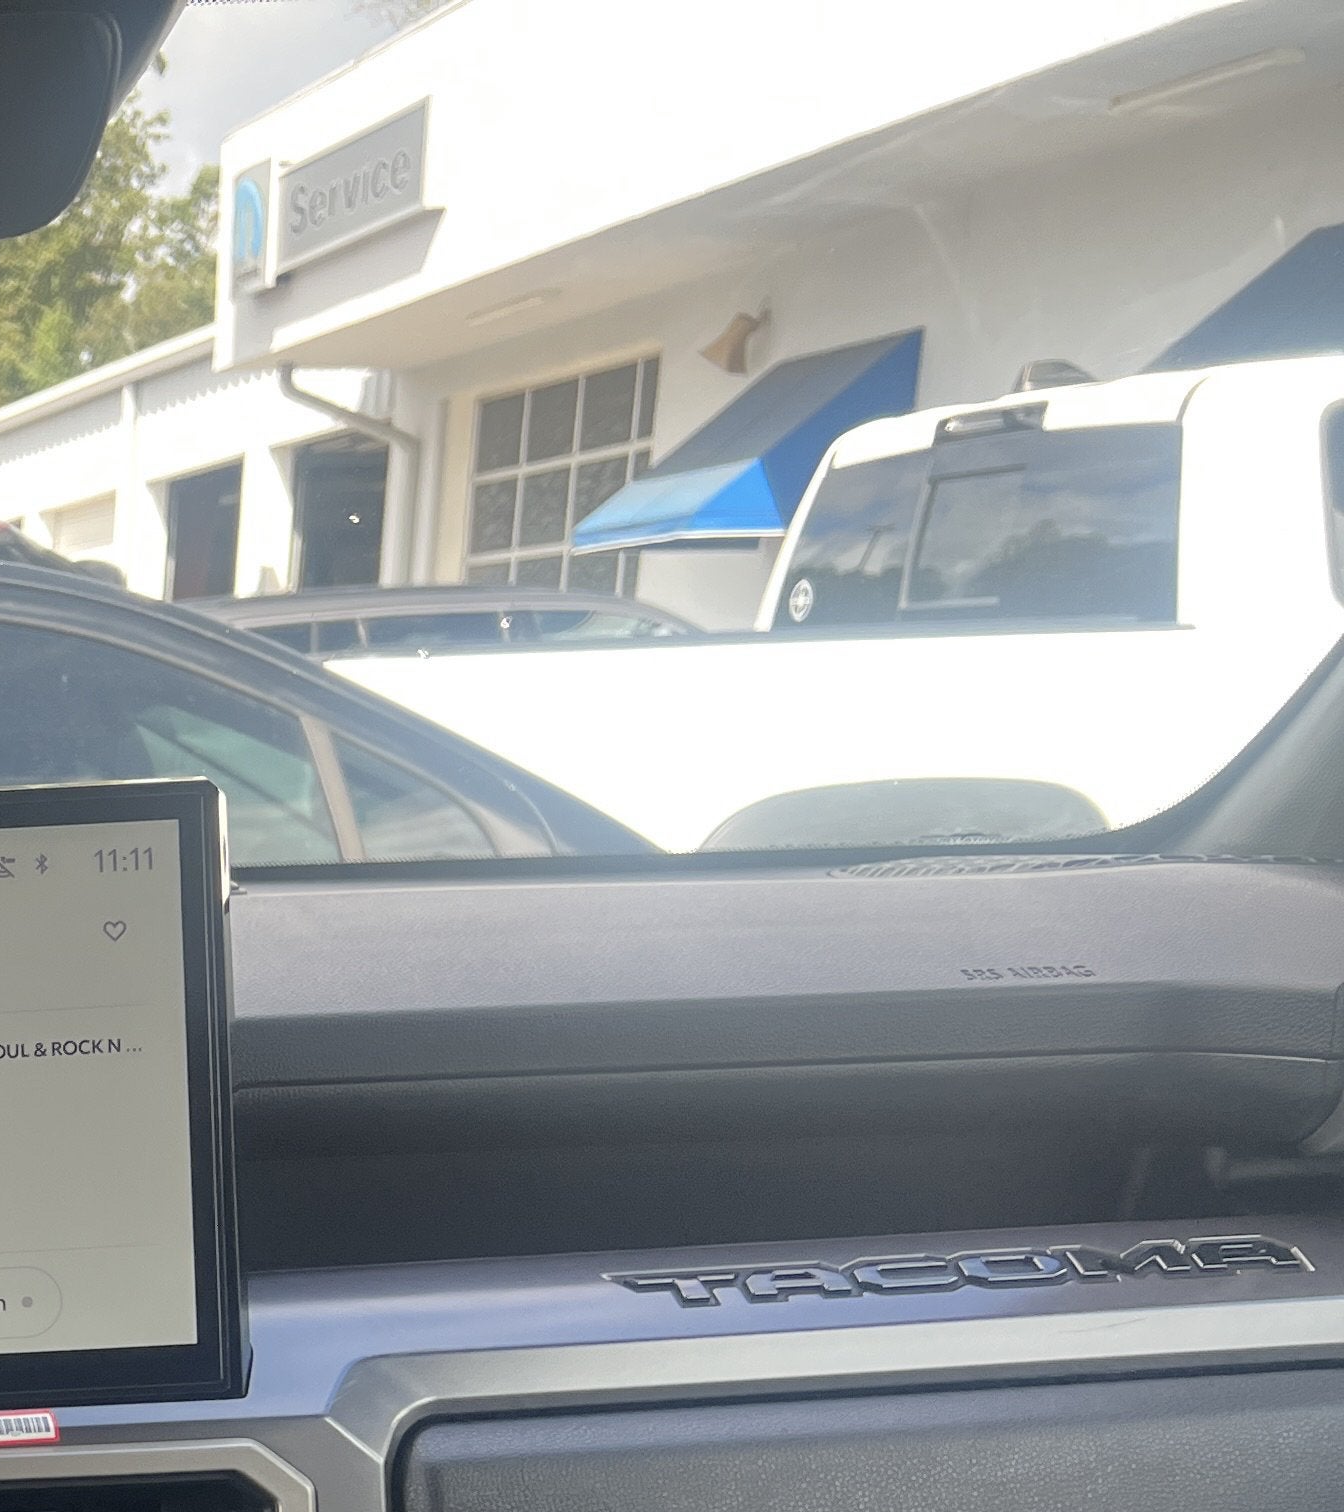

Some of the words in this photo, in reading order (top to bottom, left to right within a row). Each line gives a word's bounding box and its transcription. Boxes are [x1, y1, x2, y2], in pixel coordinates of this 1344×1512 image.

[289, 149, 411, 235] Service
[93, 847, 155, 872] 11:11
[960, 969, 1004, 981] SRS
[1007, 965, 1097, 979] AIRBAG
[34, 1043, 47, 1058] &
[51, 1039, 104, 1058] ROCK
[108, 1038, 121, 1054] N
[599, 1233, 1316, 1308] TACOMA
